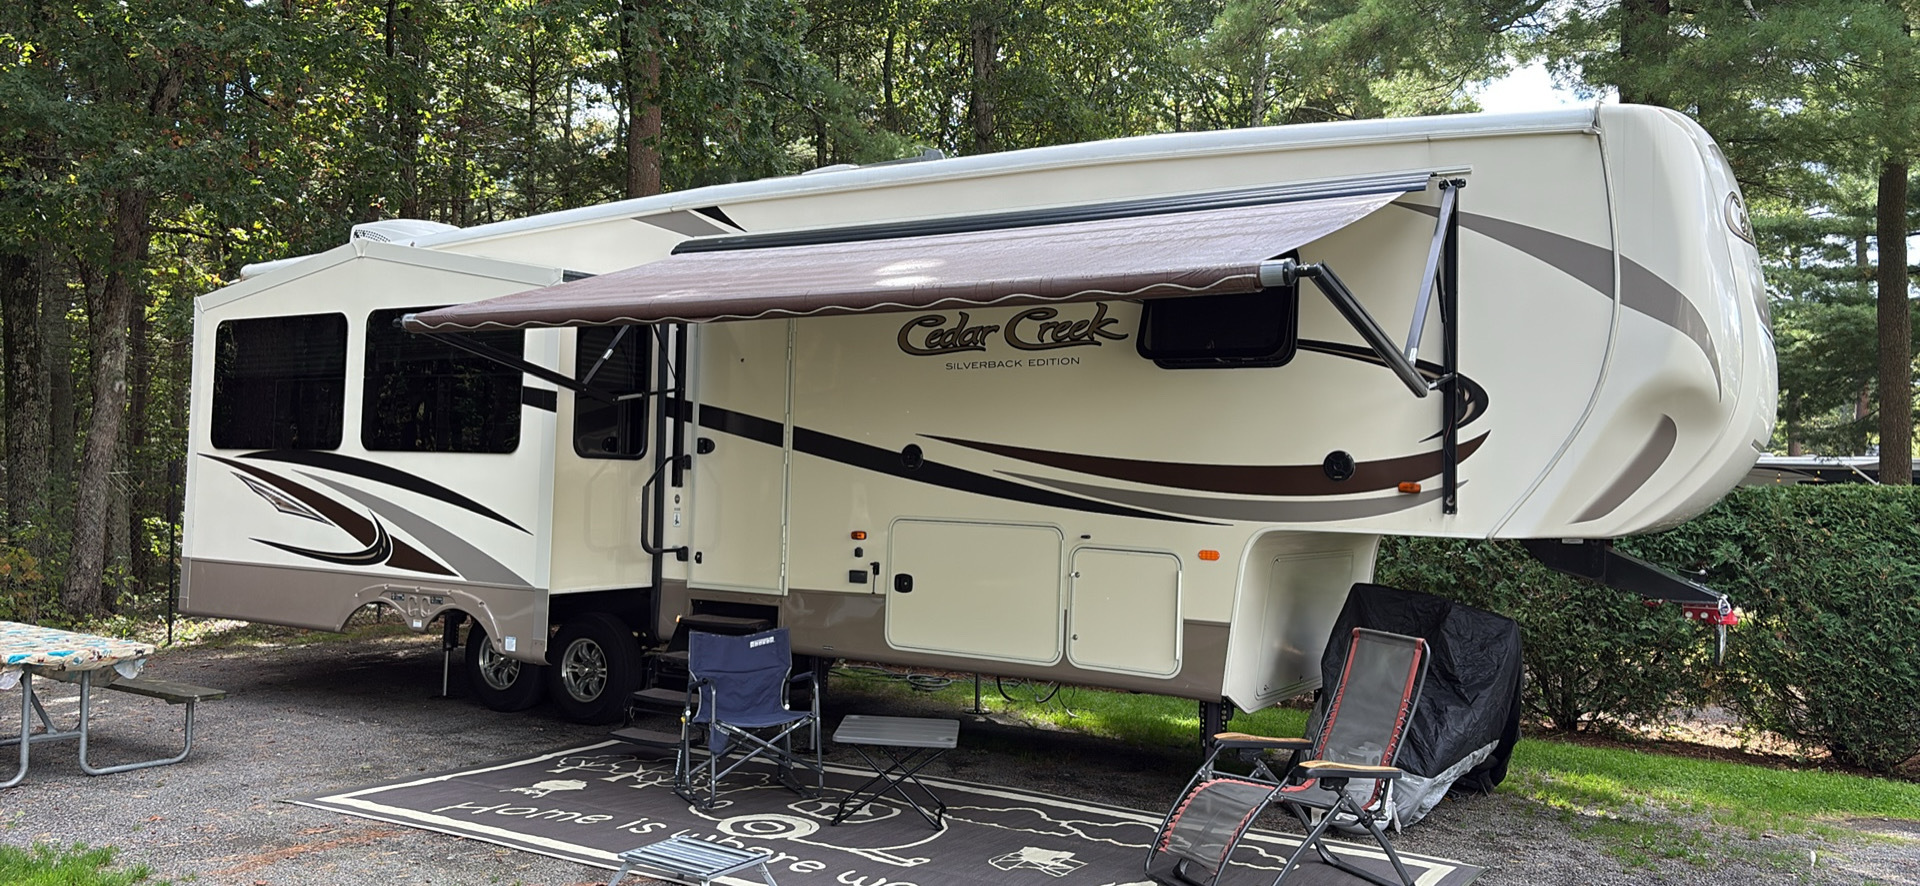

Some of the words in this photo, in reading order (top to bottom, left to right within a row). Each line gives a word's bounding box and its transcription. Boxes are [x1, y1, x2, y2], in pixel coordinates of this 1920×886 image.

[897, 311, 1000, 356] Cedar
[1004, 302, 1129, 351] Creek
[945, 359, 1022, 370] SILVERBACK
[1028, 357, 1080, 367] EDITION
[432, 802, 613, 824] Home
[616, 818, 667, 833] is
[836, 870, 921, 886] w
